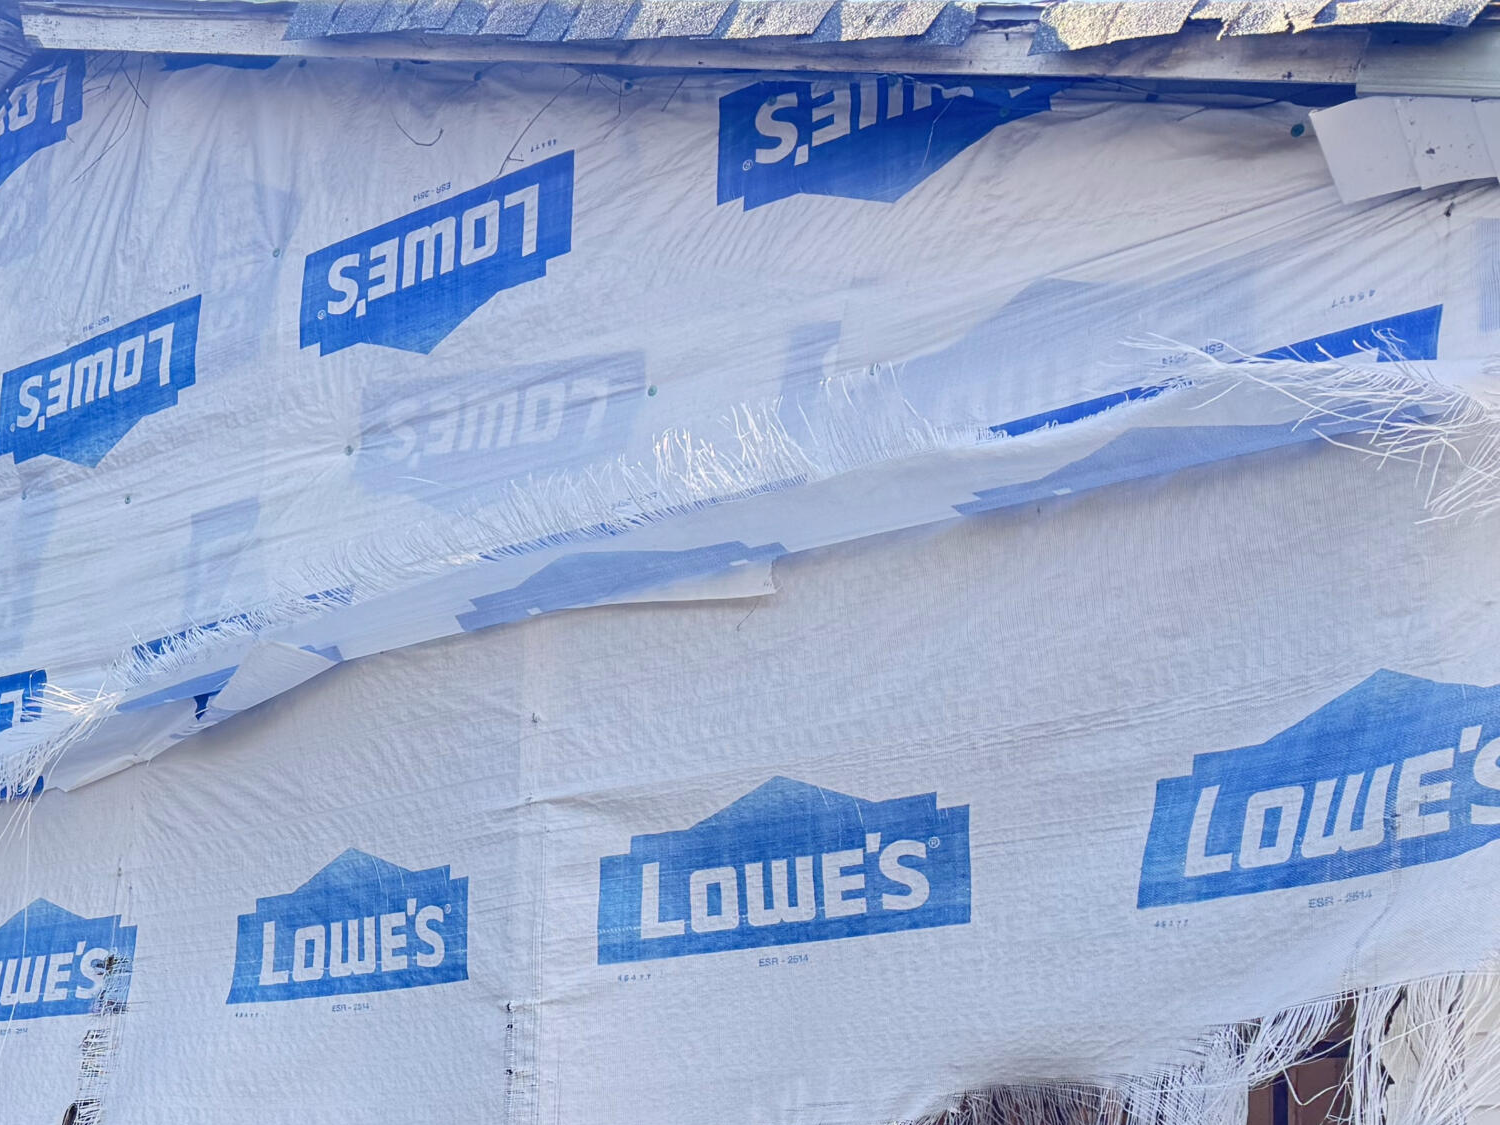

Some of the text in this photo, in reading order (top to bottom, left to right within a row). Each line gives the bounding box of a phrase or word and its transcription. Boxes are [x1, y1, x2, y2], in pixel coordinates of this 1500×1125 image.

[326, 183, 541, 319] LOWE'S
[17, 324, 173, 432] LOWE'S
[641, 833, 931, 941] LOWE'S
[258, 897, 446, 987] LOWE'S
